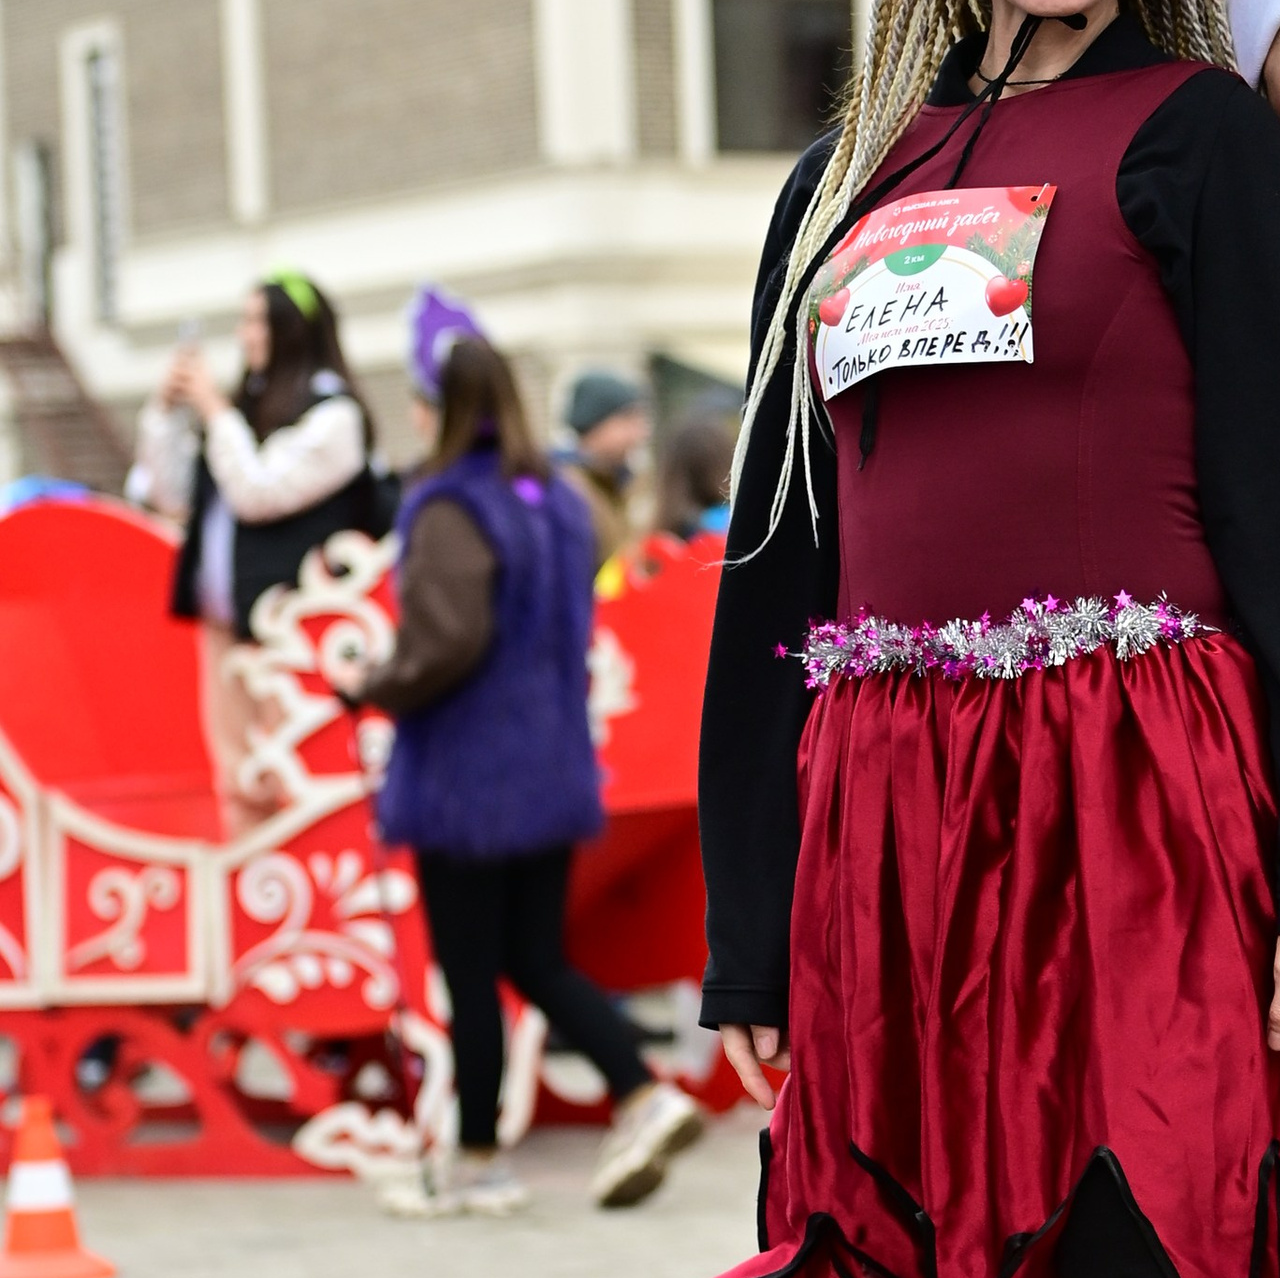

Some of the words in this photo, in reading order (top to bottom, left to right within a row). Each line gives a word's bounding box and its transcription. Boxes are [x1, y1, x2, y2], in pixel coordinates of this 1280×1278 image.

[853, 211, 950, 251] Новогодний
[946, 205, 1001, 236] забег
[903, 255, 911, 265] 2
[845, 286, 949, 334] ЕЛЕНА
[856, 331, 880, 346] Моя
[904, 324, 919, 334] на
[832, 344, 892, 390] ТОЛЬКО
